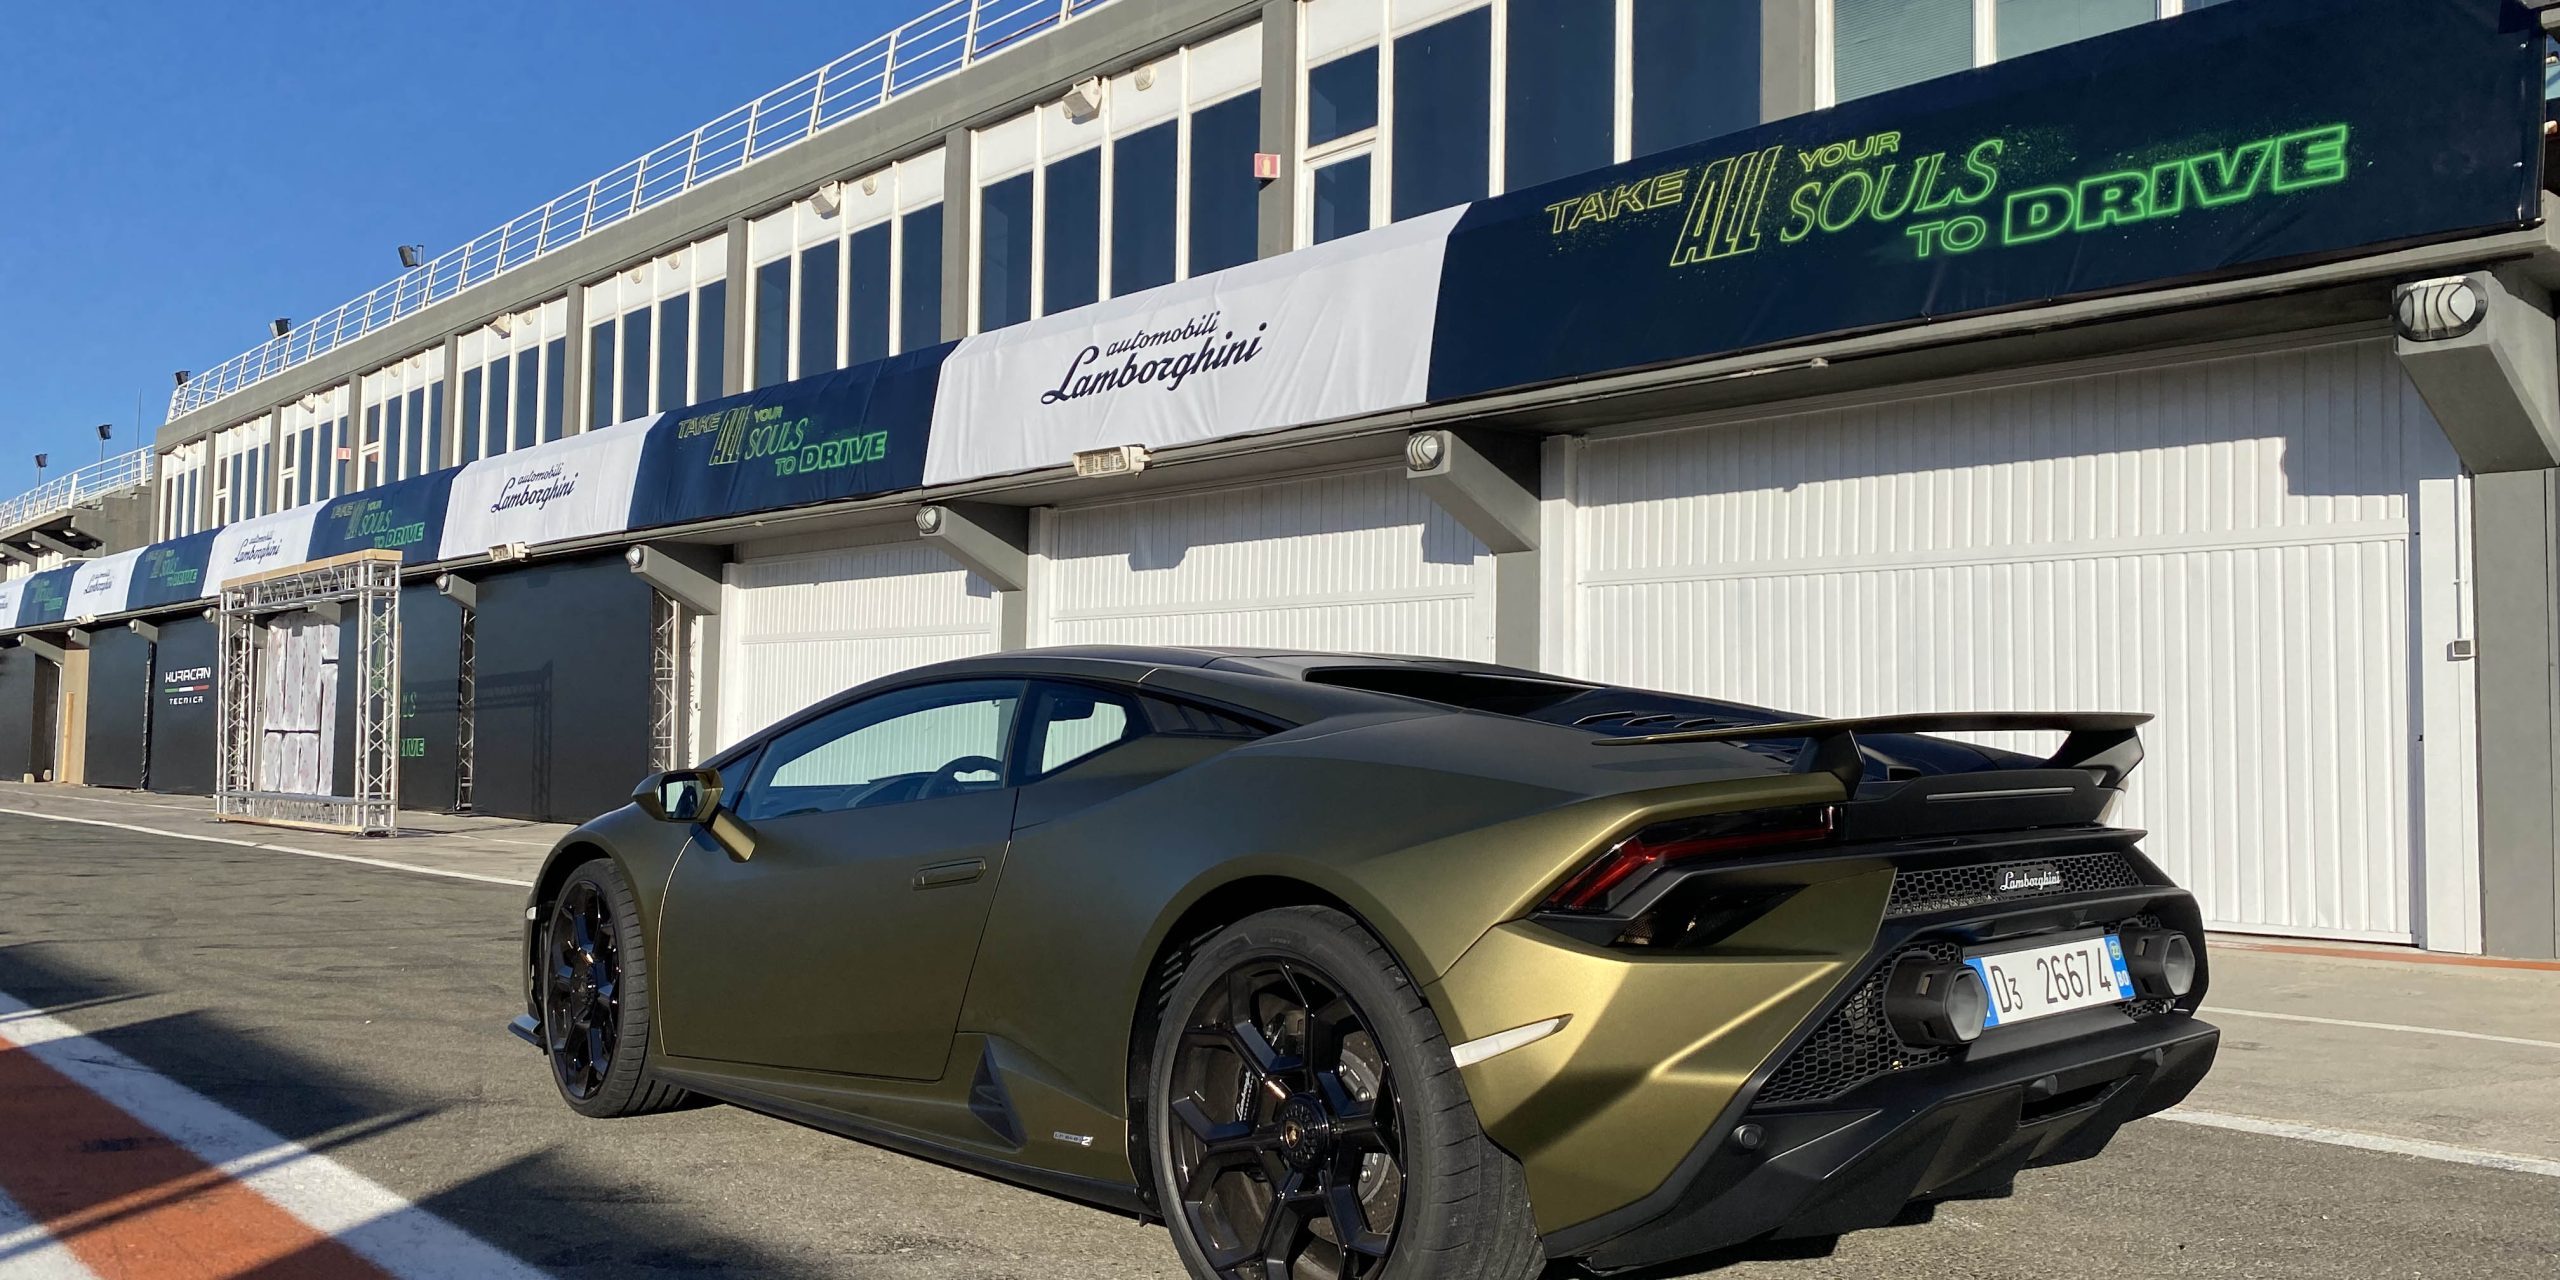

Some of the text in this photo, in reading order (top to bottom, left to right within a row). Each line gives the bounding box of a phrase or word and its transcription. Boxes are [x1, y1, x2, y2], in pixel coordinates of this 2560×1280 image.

[1545, 131, 1901, 267] TAKE ALL YOUR
[1779, 138, 2004, 242] SOULS
[1906, 123, 2348, 258] TO DRIVE
[1106, 310, 1222, 358] automobili
[1040, 321, 1268, 405] Lamborghini
[678, 404, 784, 466] TAKE ALL YOUR
[744, 417, 808, 460] SOULS
[775, 430, 888, 476] TO DRIVE
[490, 472, 579, 513] Lamborghini
[517, 462, 565, 485] automobili
[358, 509, 393, 537] SOULS
[385, 521, 425, 548] DRIVE
[169, 695, 204, 705] TECNICA
[2000, 871, 2061, 891] Lamborghini
[2036, 947, 2112, 1004] 26674
